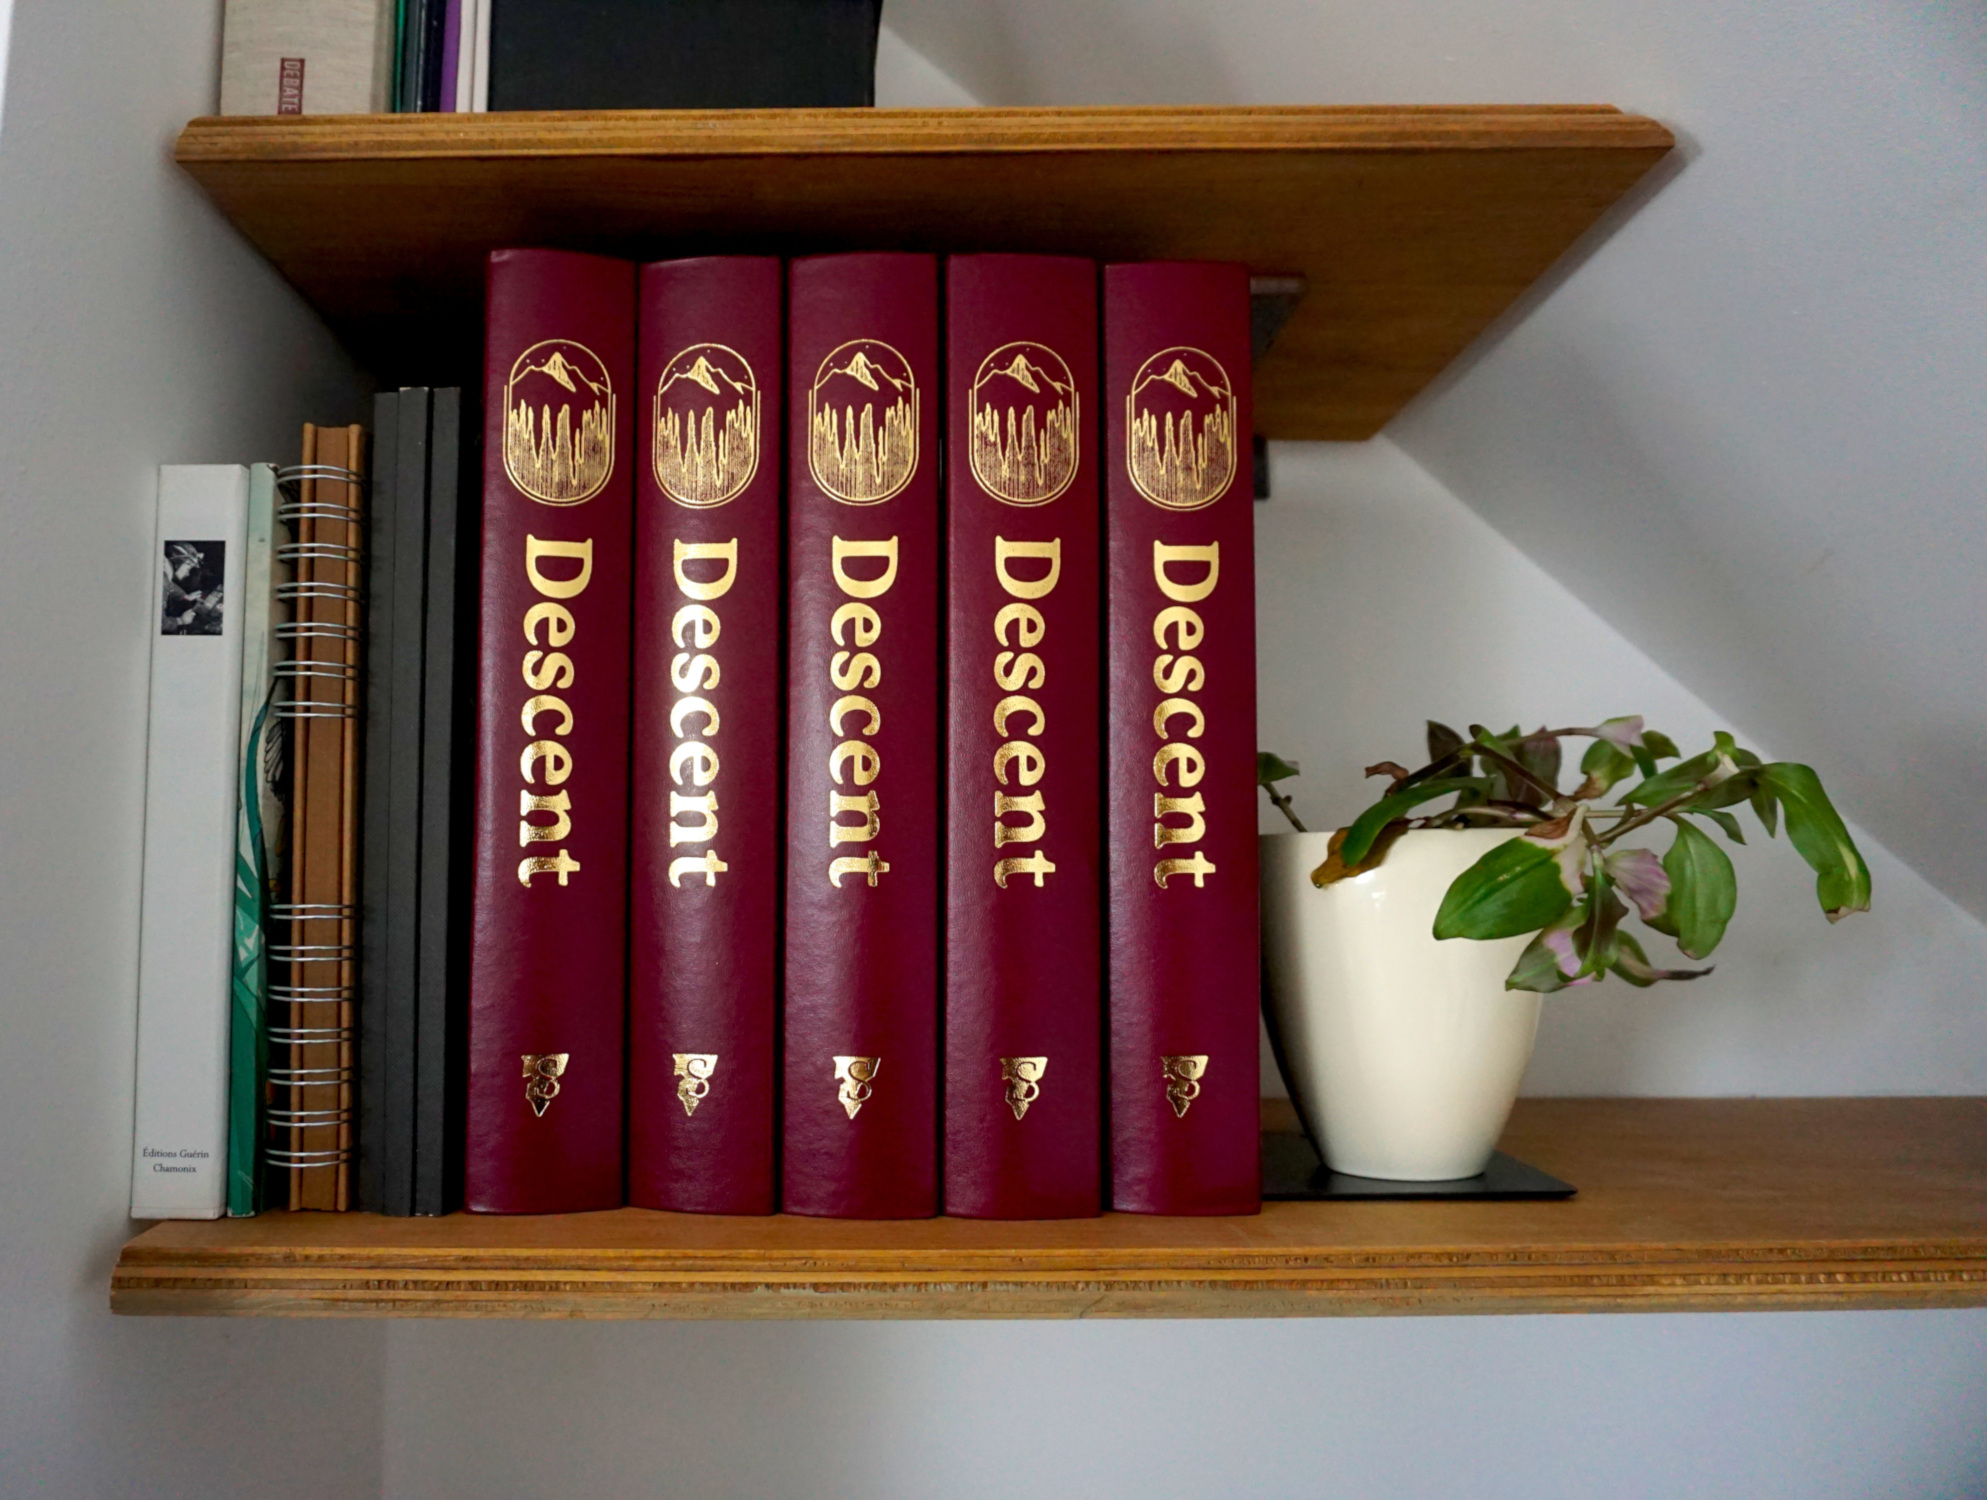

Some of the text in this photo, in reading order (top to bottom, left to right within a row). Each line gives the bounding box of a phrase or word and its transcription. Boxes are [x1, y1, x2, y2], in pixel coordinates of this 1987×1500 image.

[281, 60, 301, 111] DEBATE
[518, 534, 592, 889] Descent
[668, 536, 738, 889] Descent
[827, 535, 898, 889] Descent
[993, 535, 1061, 889] Descent
[1153, 540, 1219, 889] Descent
[142, 1146, 209, 1159] Éditions Guérin
[153, 1163, 197, 1173] Chamonix
